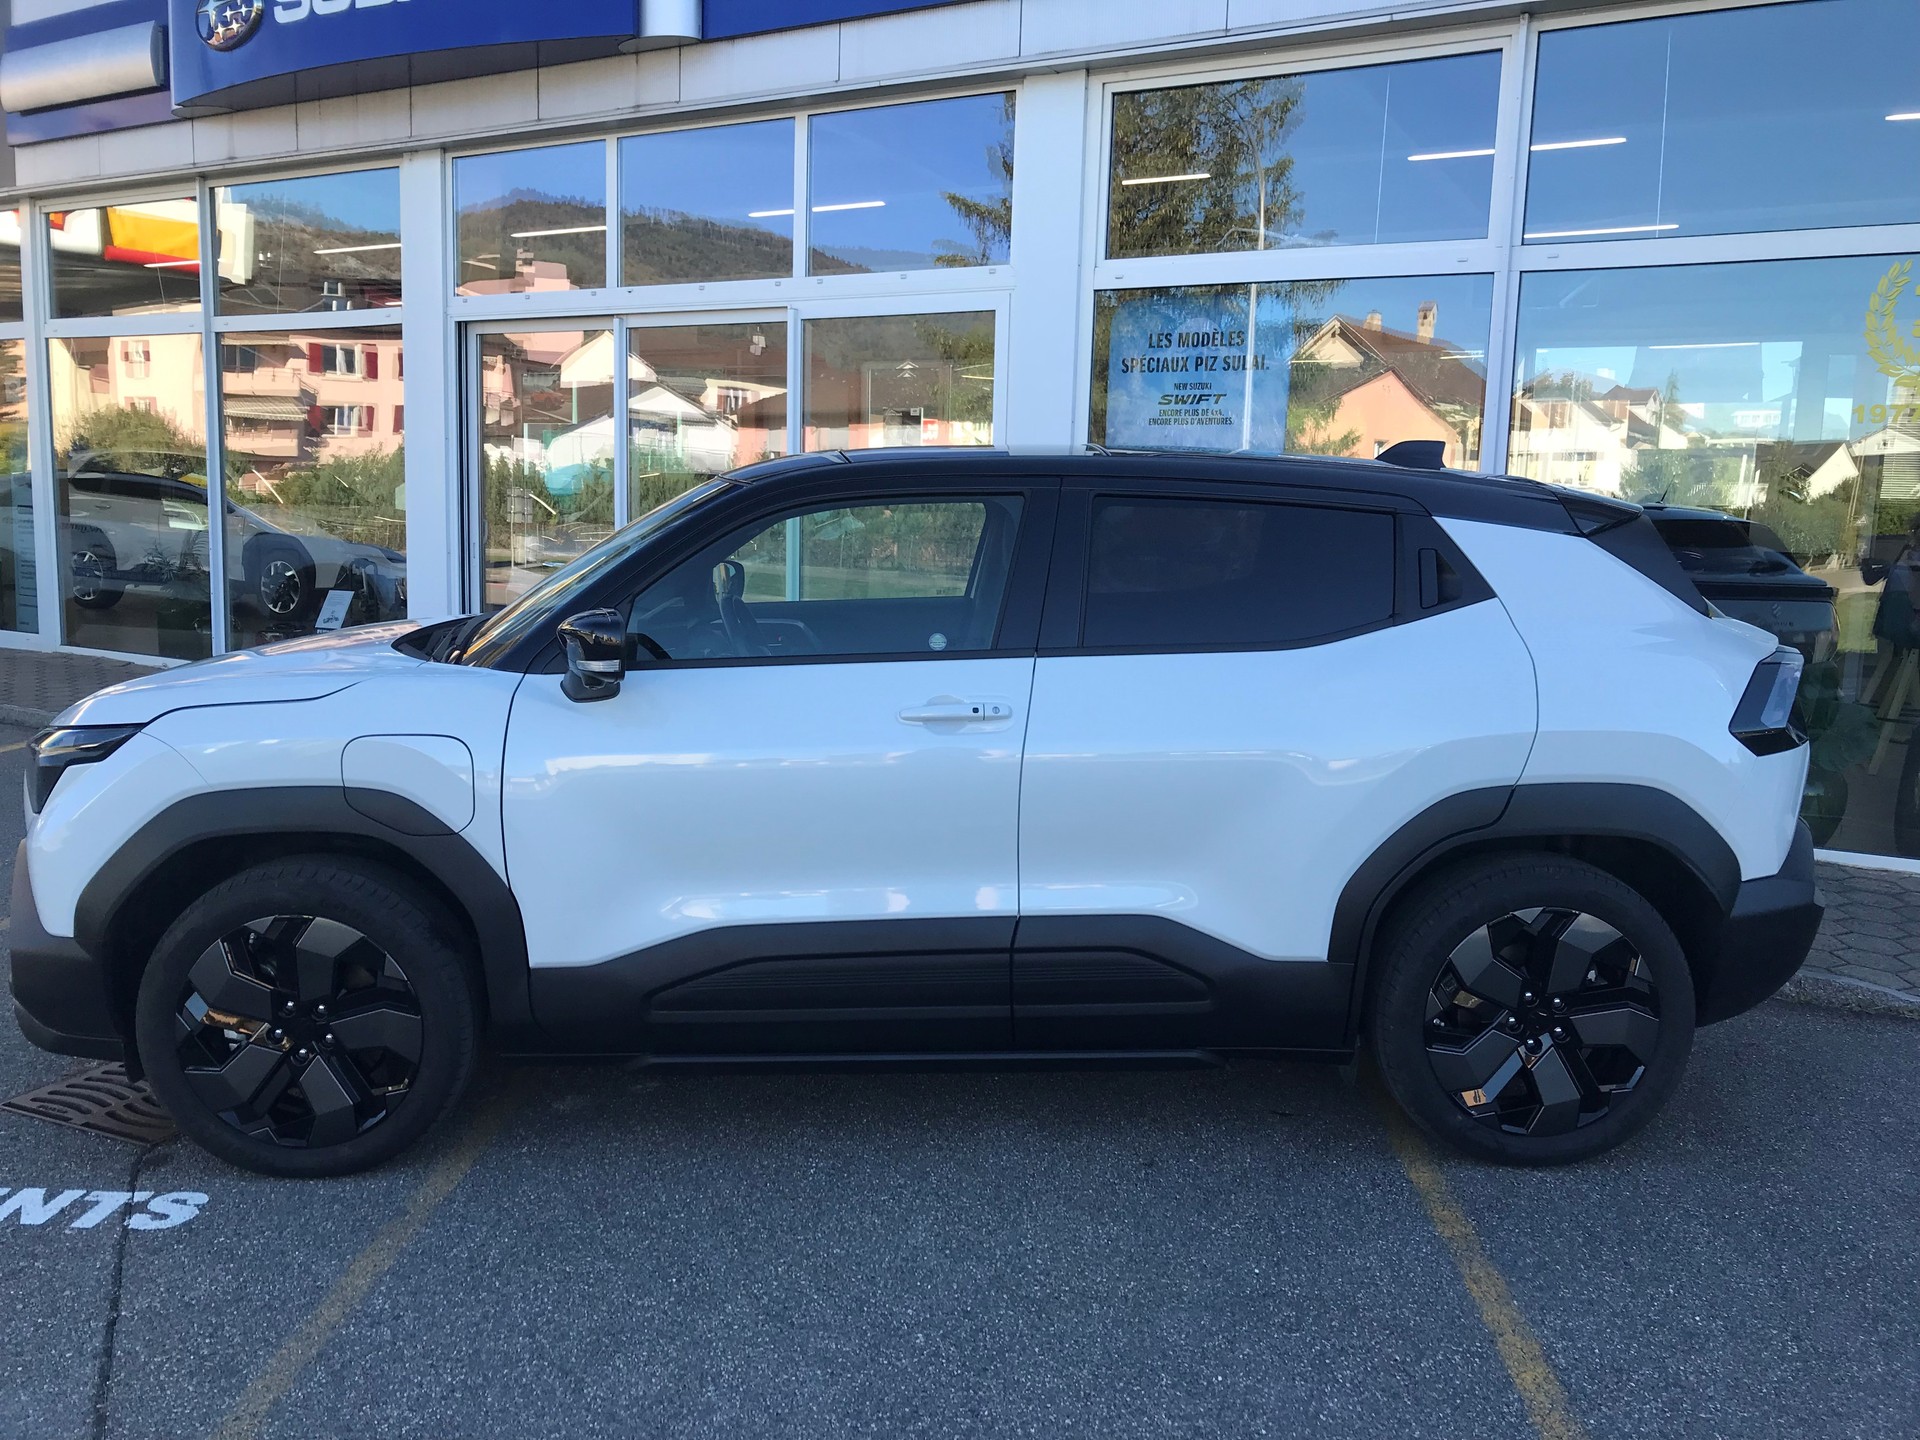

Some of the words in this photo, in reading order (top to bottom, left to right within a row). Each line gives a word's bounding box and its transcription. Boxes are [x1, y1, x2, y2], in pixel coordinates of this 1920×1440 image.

[1148, 332, 1173, 349] LES
[1178, 328, 1245, 348] MODÈLES
[1121, 353, 1190, 374] SPÉCIAUX
[1194, 355, 1218, 372] PIZ
[1174, 382, 1188, 391] NEW
[1189, 382, 1212, 391] SUZUKI
[1158, 393, 1227, 406] SWIFT
[1159, 409, 1183, 417] ENCORE
[1184, 409, 1199, 417] PLUS
[1148, 418, 1172, 426] ENCORE
[1173, 418, 1189, 426] PLUS
[0, 1187, 209, 1230] NTS
